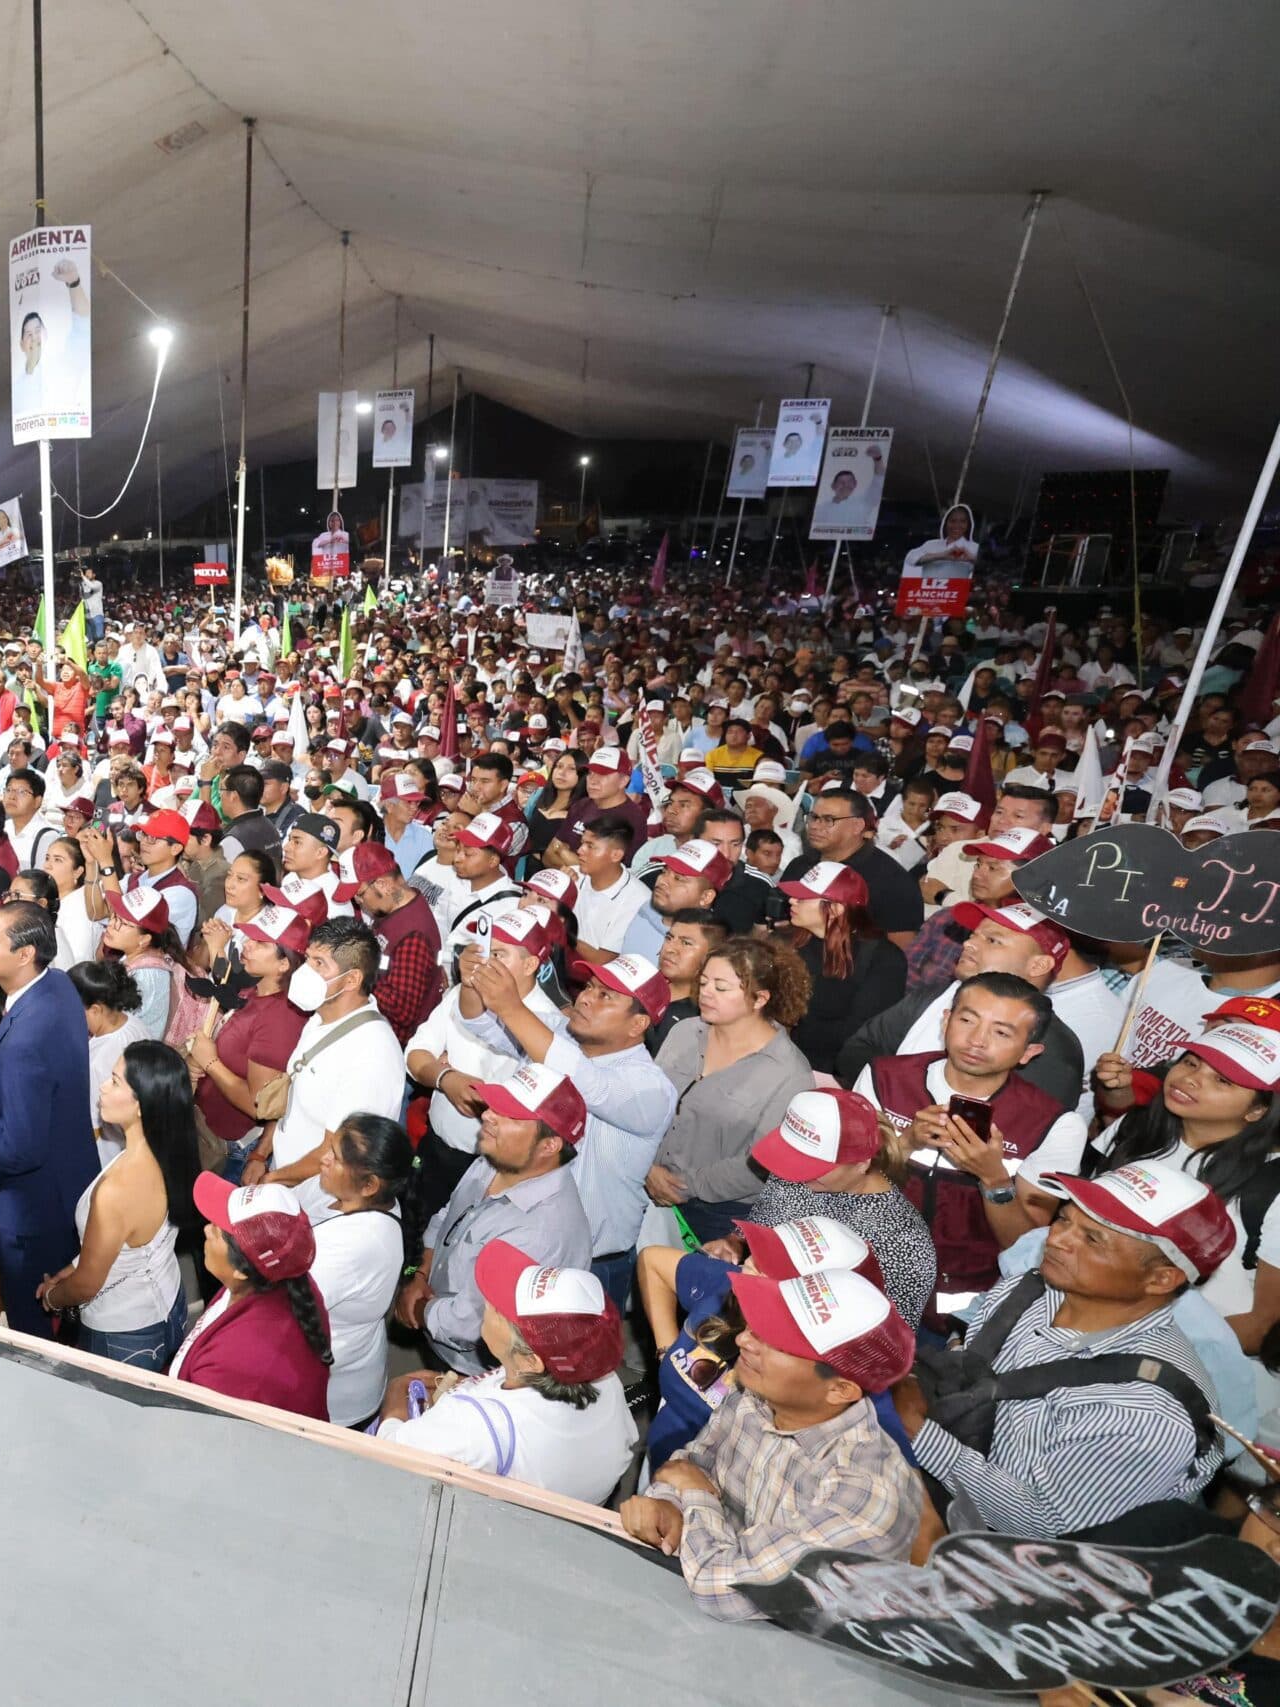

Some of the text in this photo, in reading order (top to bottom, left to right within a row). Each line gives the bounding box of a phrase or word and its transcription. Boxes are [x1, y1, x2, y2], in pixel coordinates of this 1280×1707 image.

[11, 229, 87, 257] ARMENTA
[15, 417, 45, 433] morena
[831, 429, 890, 437] ARMENTA
[921, 578, 949, 590] LIZ
[1141, 903, 1233, 945] Contigo
[1138, 1005, 1191, 1043] RMENTA
[1136, 1023, 1177, 1061] MENTA
[1218, 1028, 1277, 1062] ARMENTA
[785, 1111, 821, 1143] RMENTA
[1117, 1166, 1157, 1200] MENTA
[792, 1219, 824, 1264] RMENTA
[948, 1566, 1279, 1681] ARMENTA
